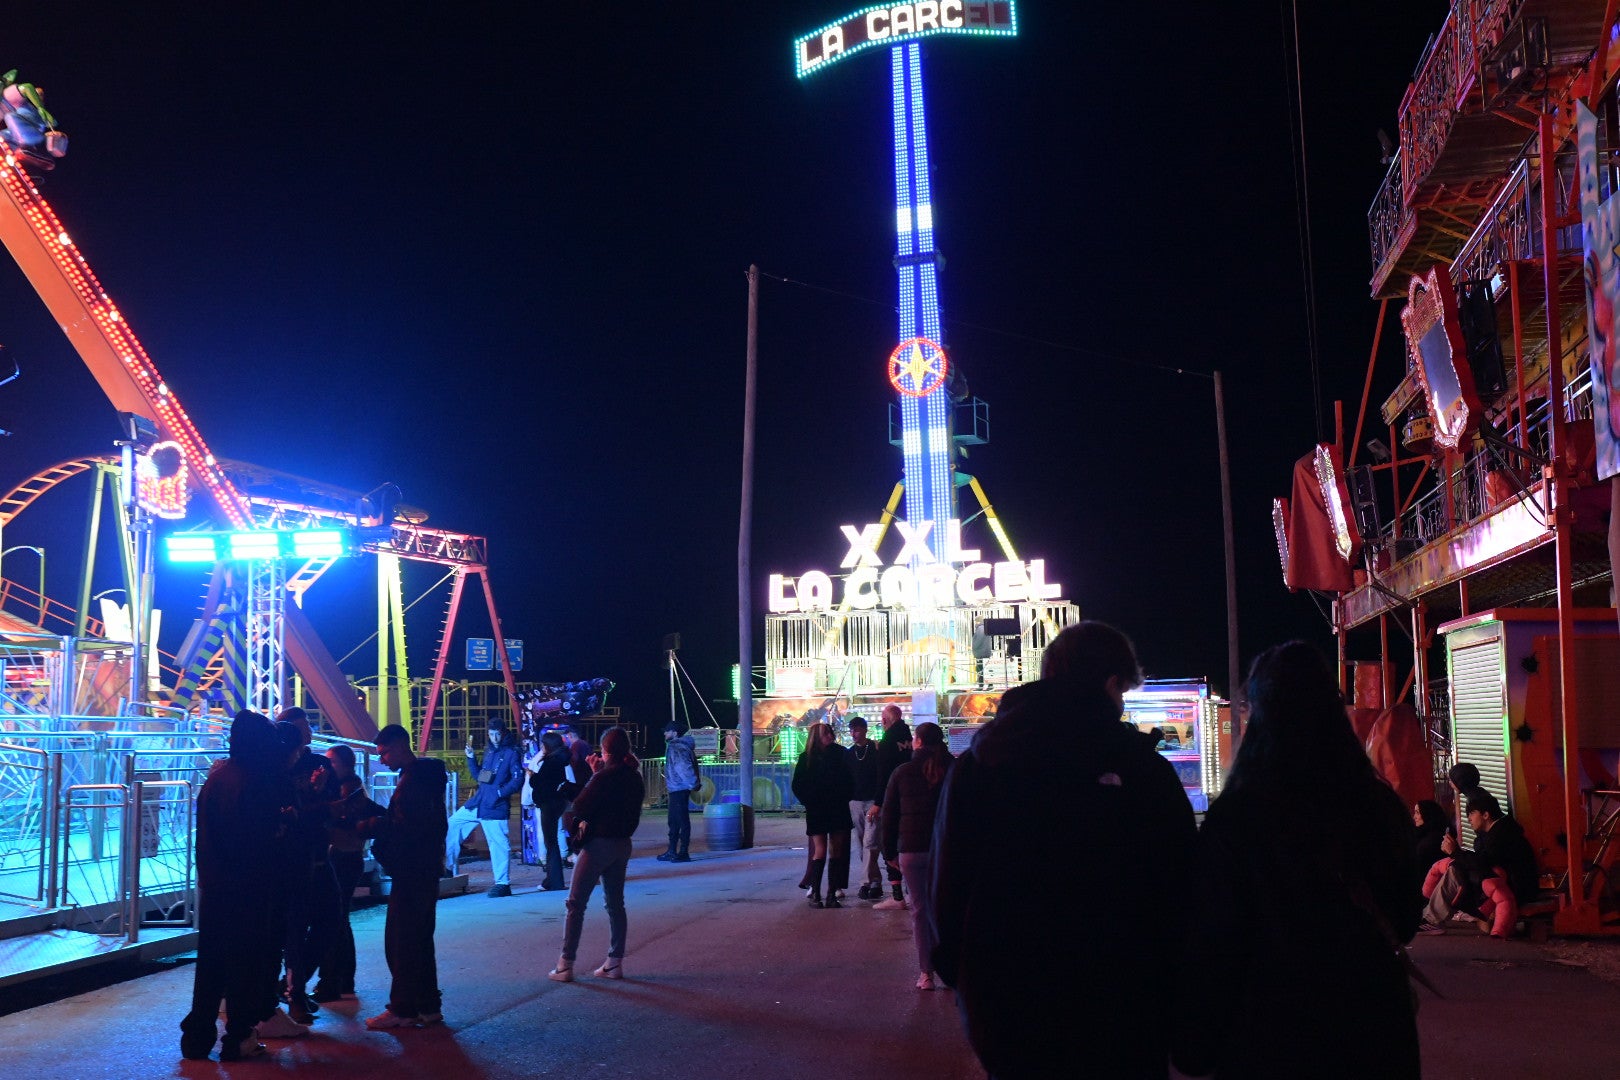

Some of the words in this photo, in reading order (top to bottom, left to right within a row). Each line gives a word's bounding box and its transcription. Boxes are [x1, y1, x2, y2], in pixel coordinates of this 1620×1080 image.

[803, 28, 844, 70] LA
[866, 0, 1012, 40] CARCEL
[840, 519, 981, 568] XXL
[769, 570, 832, 613] LA
[844, 559, 1061, 609] CARCEL
